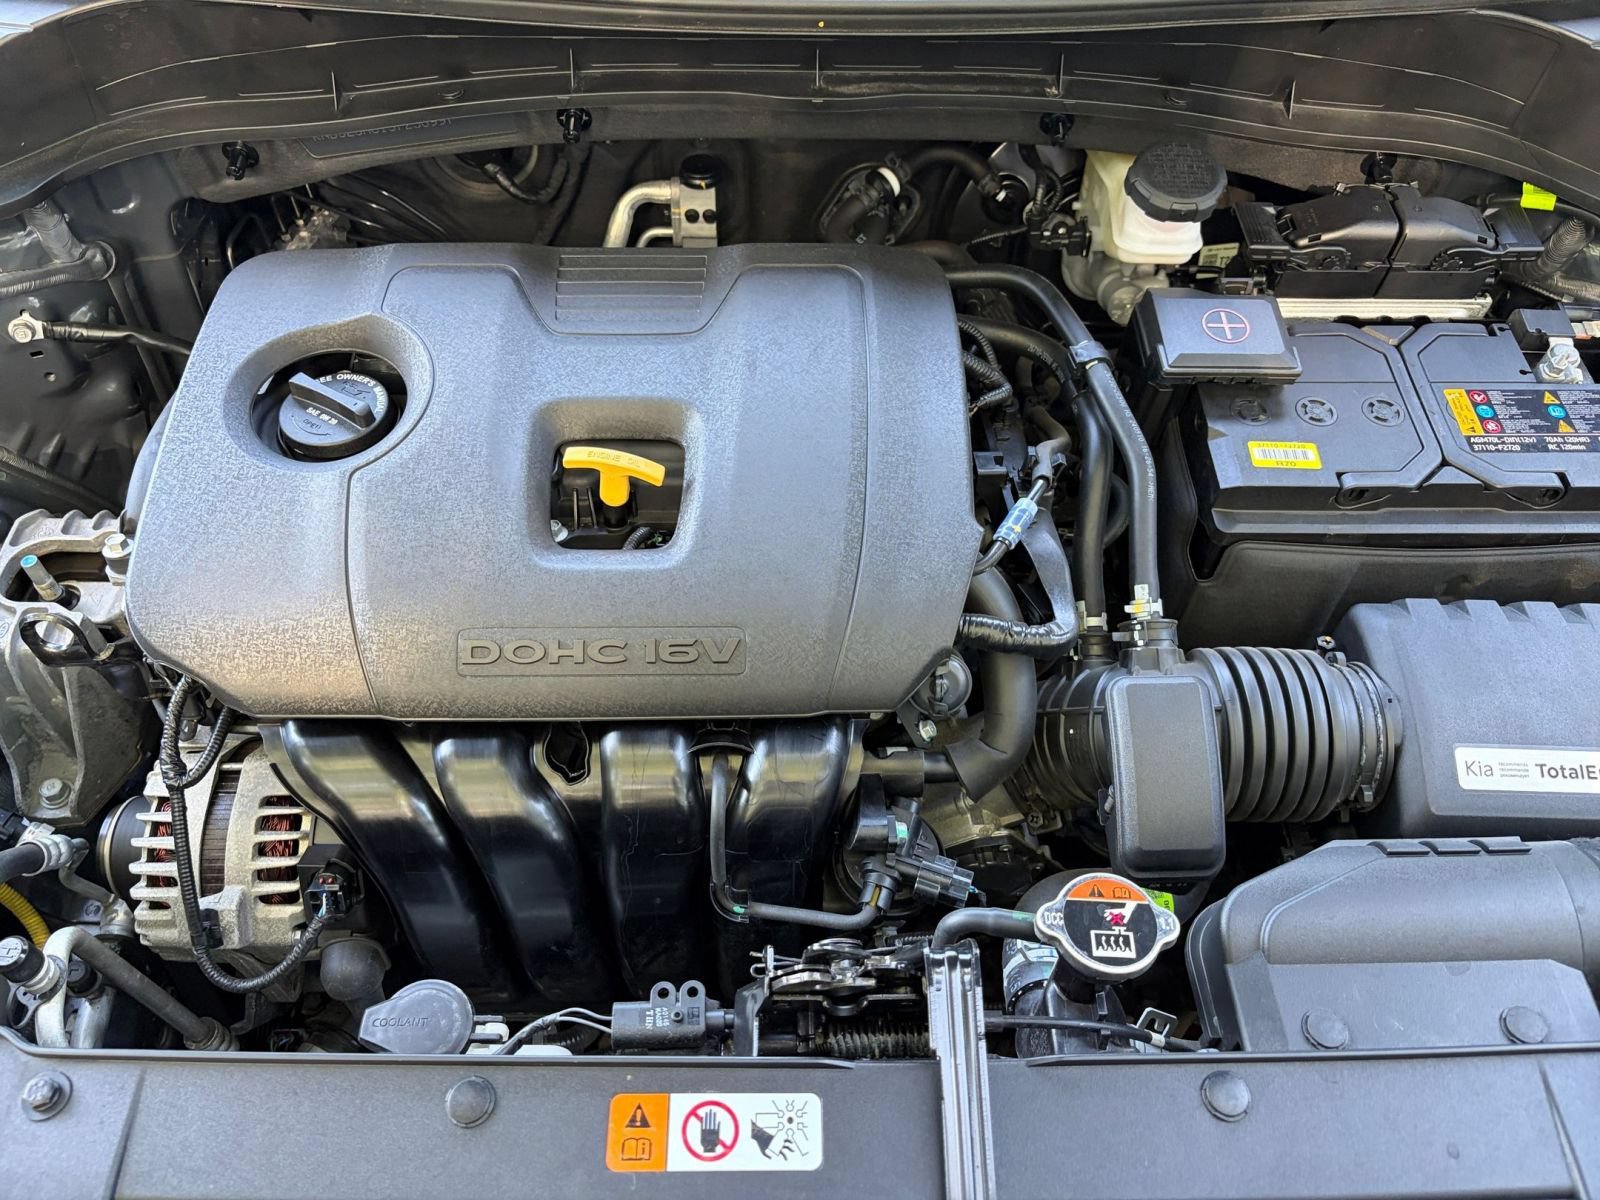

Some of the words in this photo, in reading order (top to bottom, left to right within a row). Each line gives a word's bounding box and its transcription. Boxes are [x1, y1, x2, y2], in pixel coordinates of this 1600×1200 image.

[336, 373, 376, 387] OWNER'S
[373, 386, 385, 413] MANUAL
[306, 407, 320, 417] SAE
[1565, 436, 1590, 444] (20HR)
[462, 639, 628, 665] DOHC
[643, 638, 741, 664] 16V
[1465, 760, 1494, 777] Kia
[1535, 763, 1600, 780] TotalE
[1160, 917, 1175, 930] 1.1
[372, 1017, 429, 1028] COOLANT
